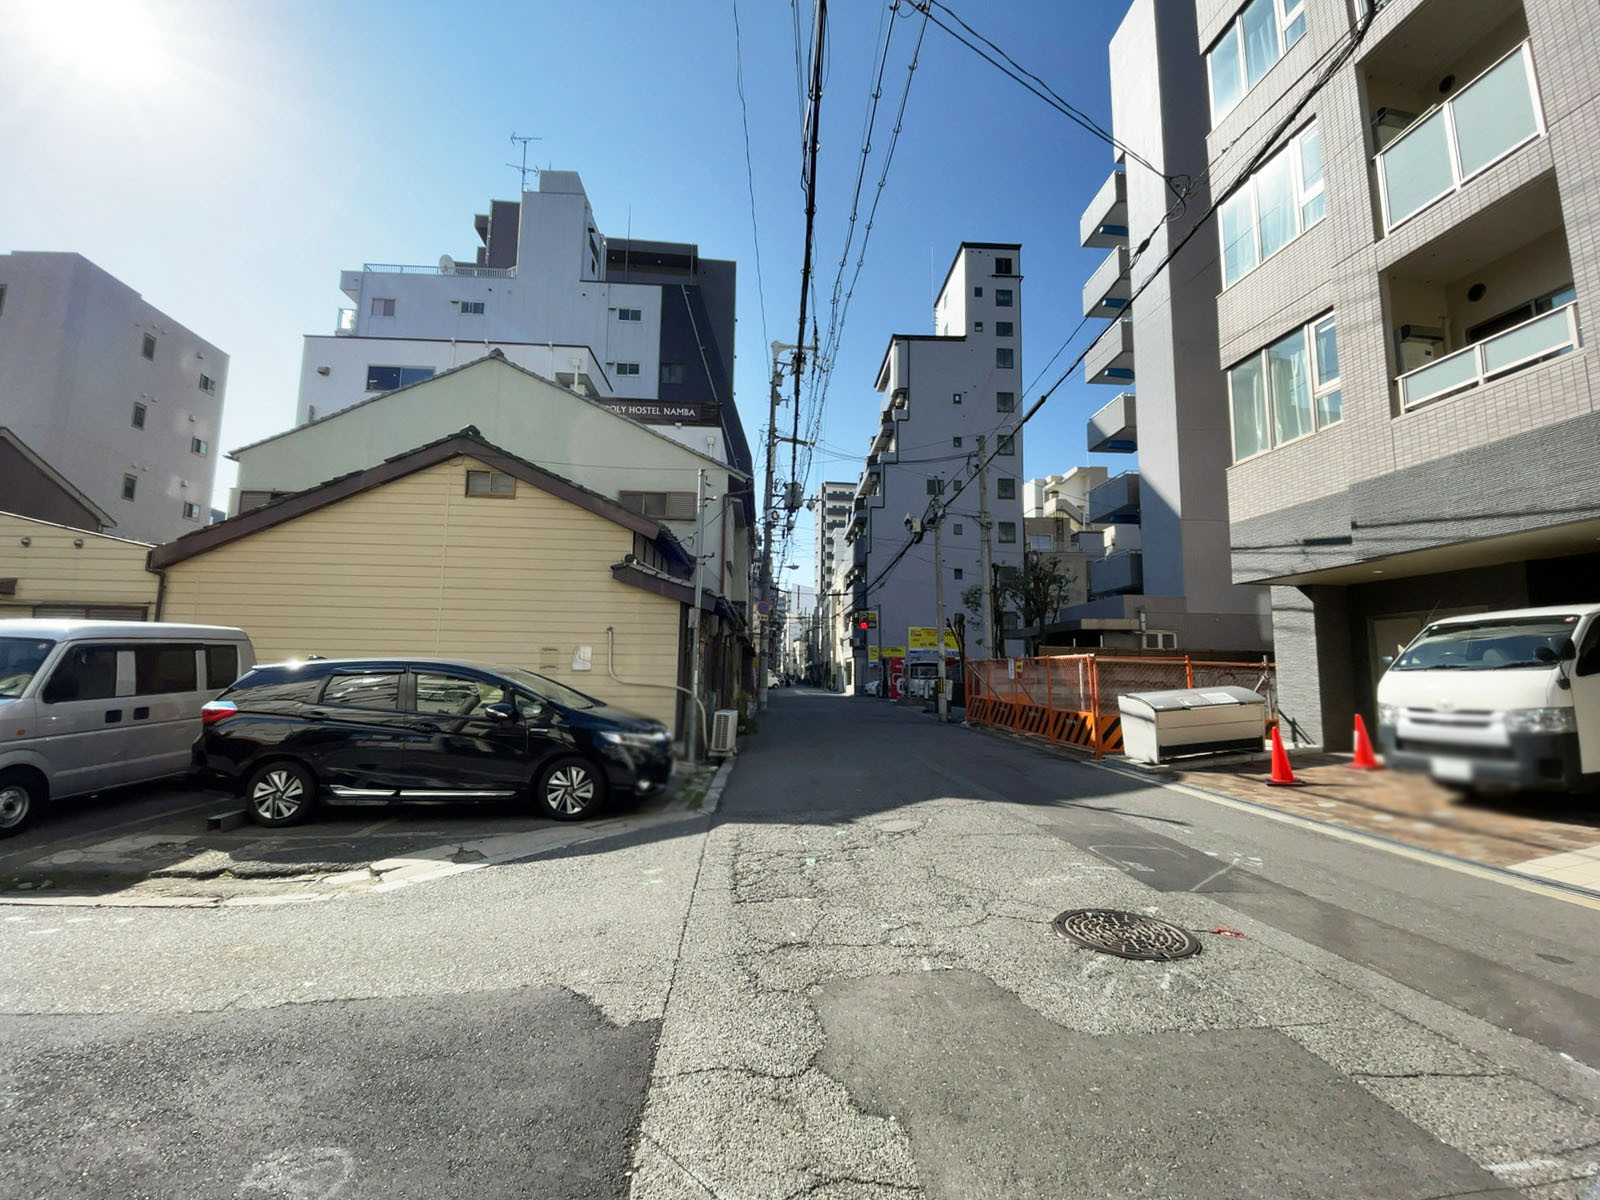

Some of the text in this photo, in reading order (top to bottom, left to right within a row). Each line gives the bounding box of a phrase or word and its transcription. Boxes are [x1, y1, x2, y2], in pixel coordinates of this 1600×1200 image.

[606, 405, 696, 416] OLY HOSTEL NAMBA
